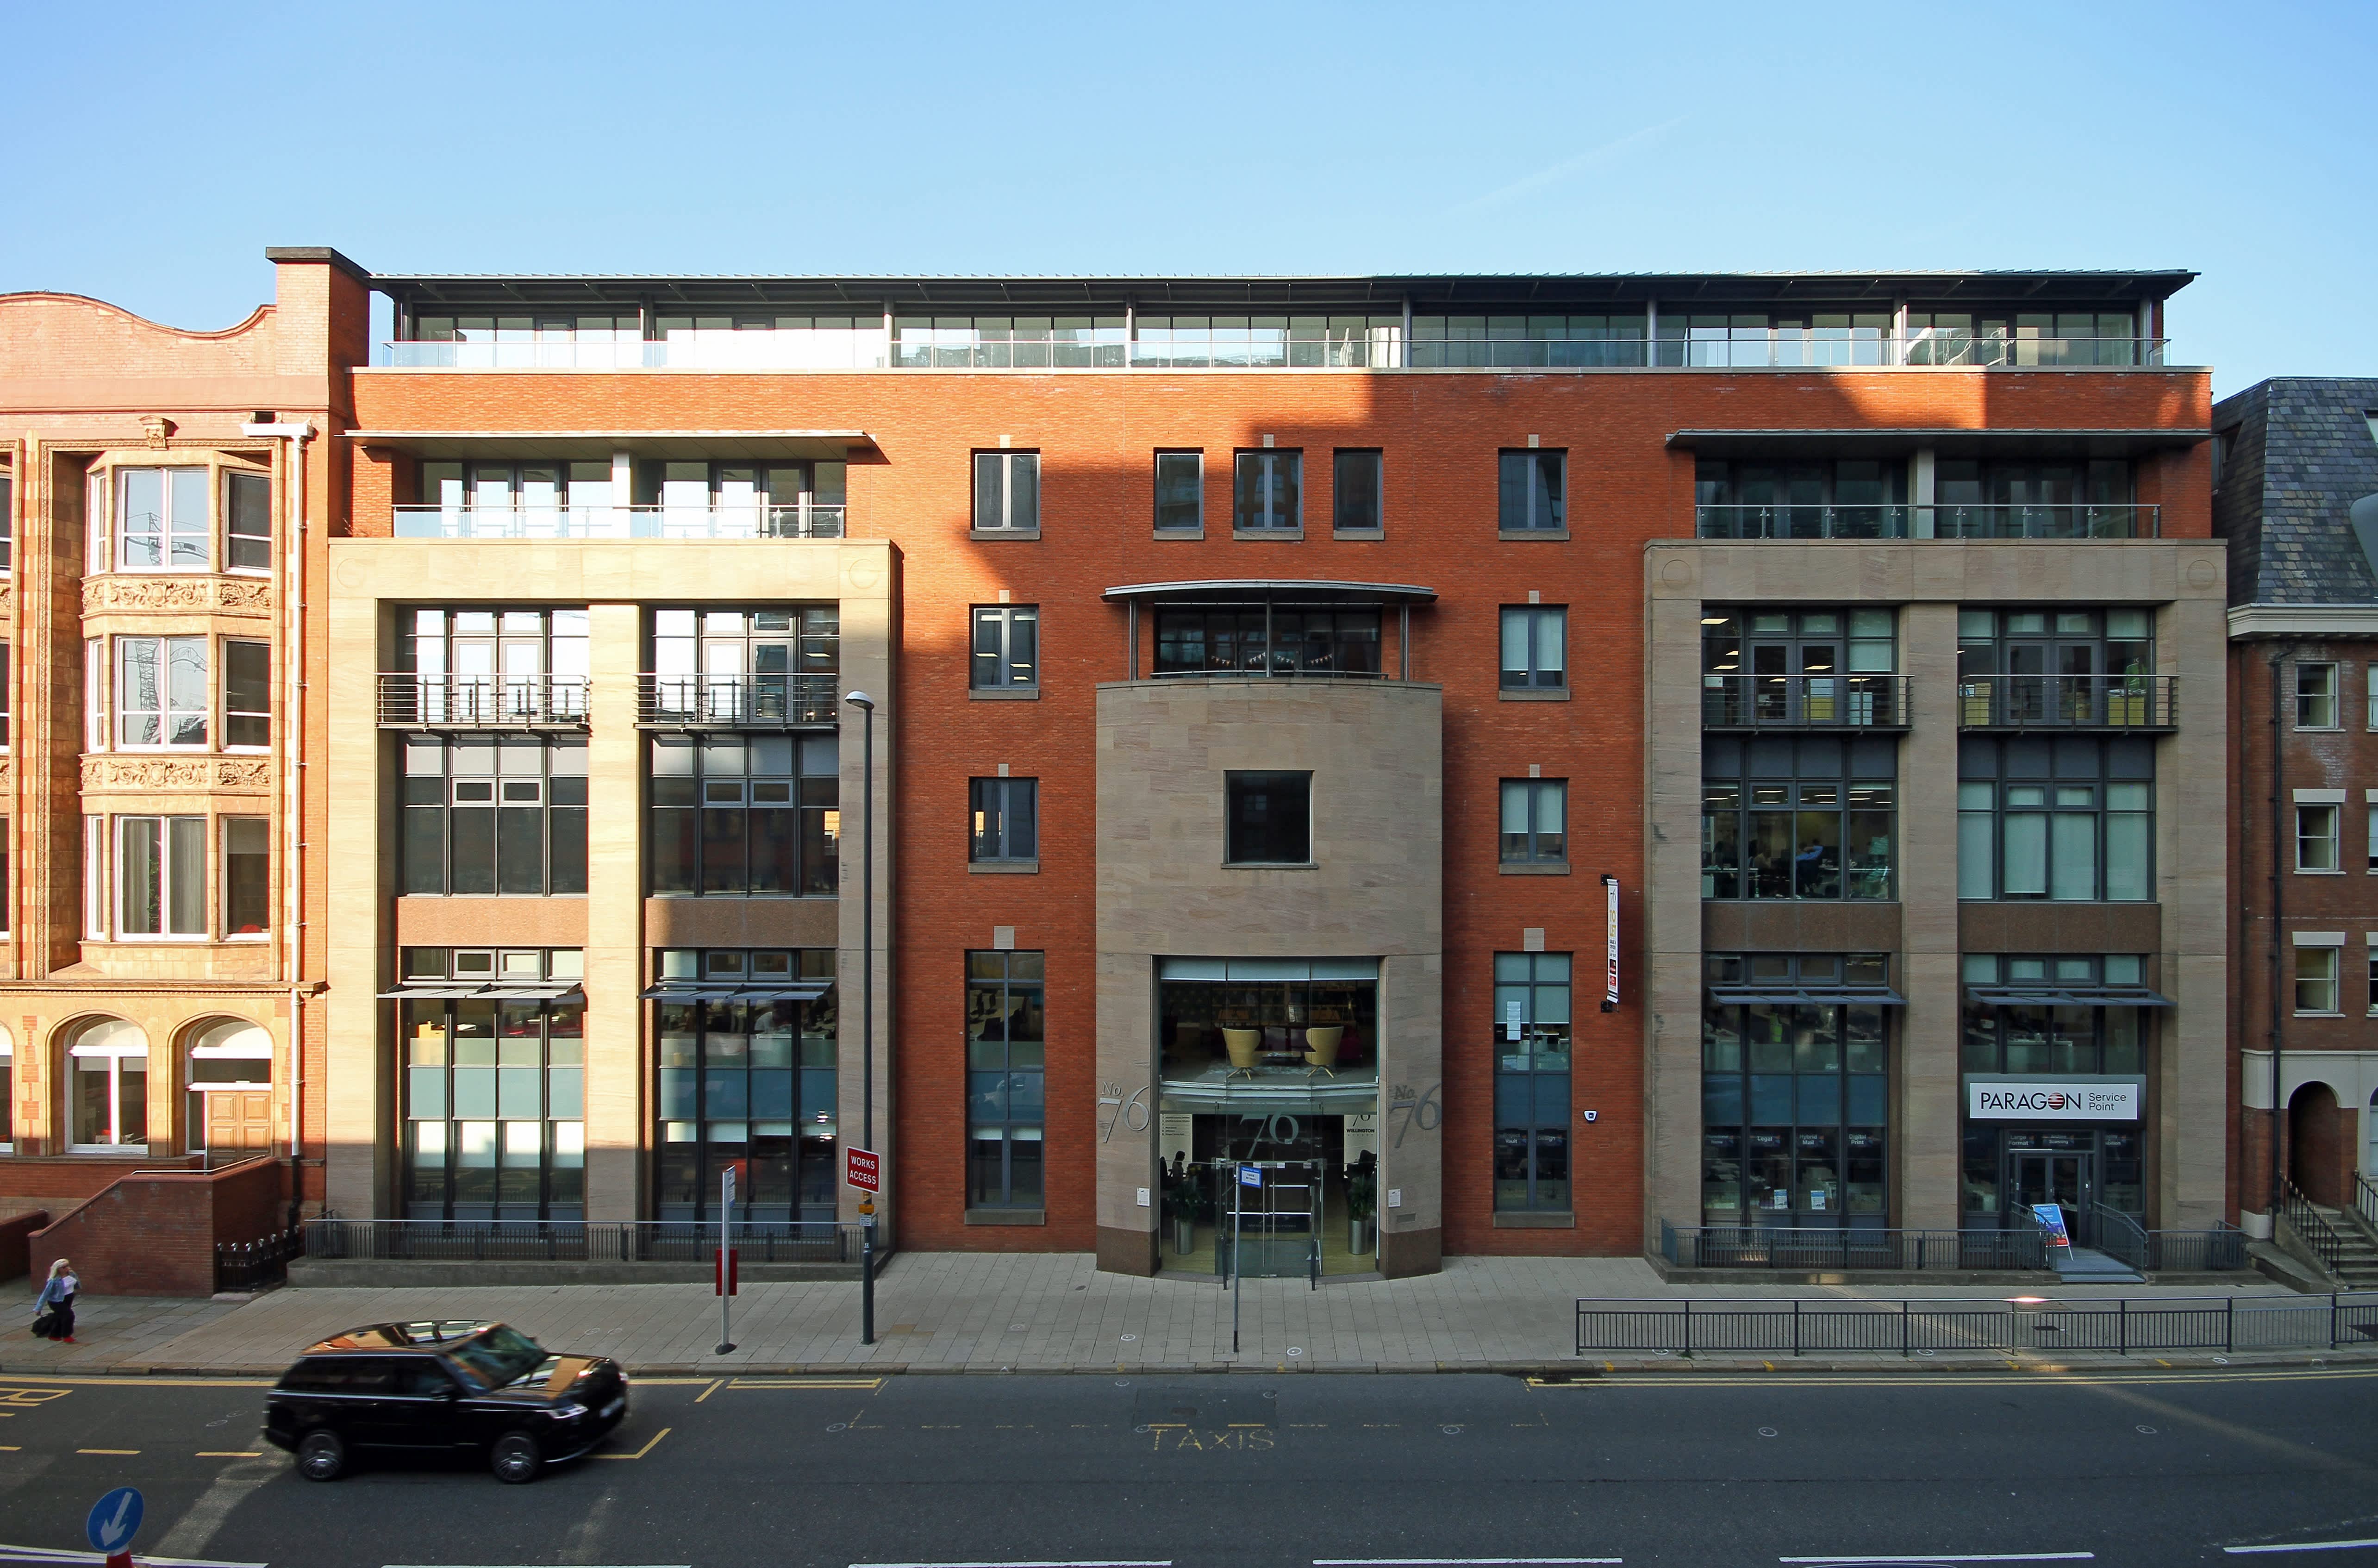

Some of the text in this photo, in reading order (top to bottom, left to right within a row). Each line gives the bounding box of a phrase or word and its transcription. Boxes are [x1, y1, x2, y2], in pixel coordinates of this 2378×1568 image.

[1610, 910, 1616, 923] TO
[1101, 1081, 1124, 1097] No.
[1981, 1092, 2081, 1110] PARAGON
[2089, 1093, 2126, 1102] Service
[1097, 1085, 1150, 1143] 76
[2089, 1102, 2115, 1111] Point
[1388, 1082, 1442, 1149] 76
[1239, 1105, 1299, 1159] 76
[851, 1156, 875, 1170] WORKS
[849, 1170, 876, 1185] ACCESS
[1150, 1429, 1274, 1450] TAXIS
